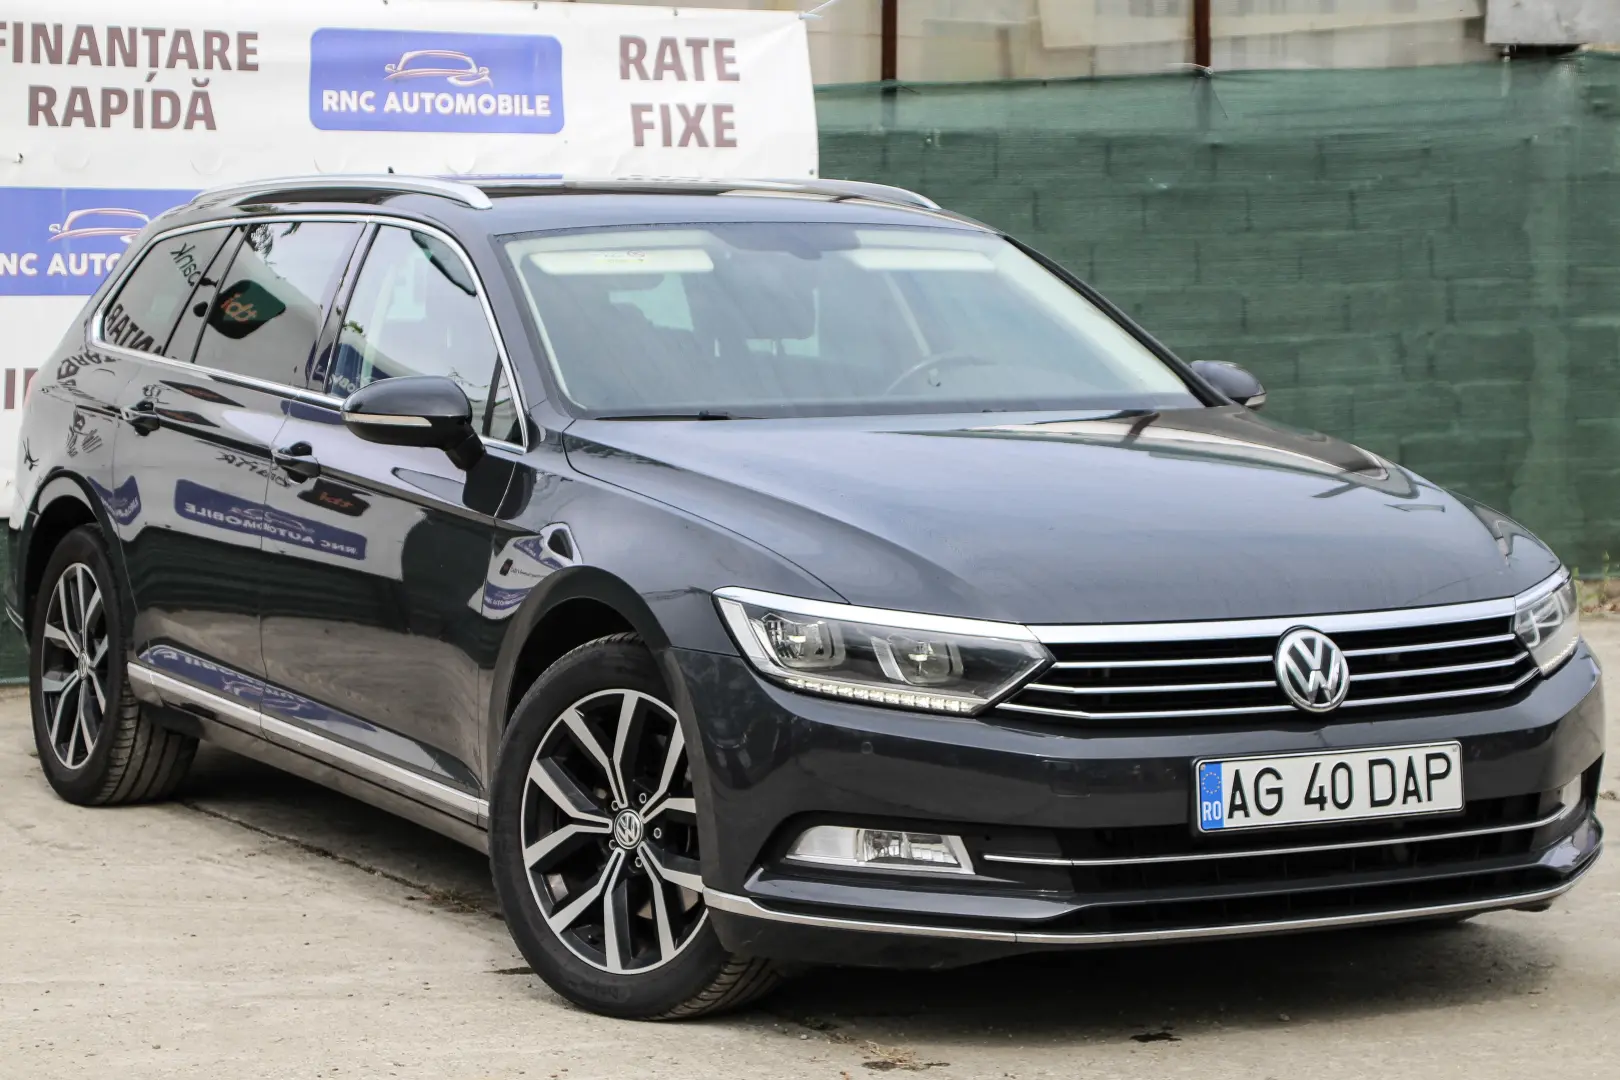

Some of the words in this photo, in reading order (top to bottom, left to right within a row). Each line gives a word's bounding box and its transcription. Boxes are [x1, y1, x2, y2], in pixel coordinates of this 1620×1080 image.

[619, 35, 740, 81] RATE
[322, 89, 375, 112] RNC
[384, 91, 551, 117] AUTOMOBILE
[630, 103, 737, 147] FIXE
[0, 252, 38, 276] NC
[1227, 767, 1283, 819] AG
[1304, 762, 1354, 811] 40
[1369, 752, 1452, 808] DAP
[1203, 801, 1222, 821] RO
